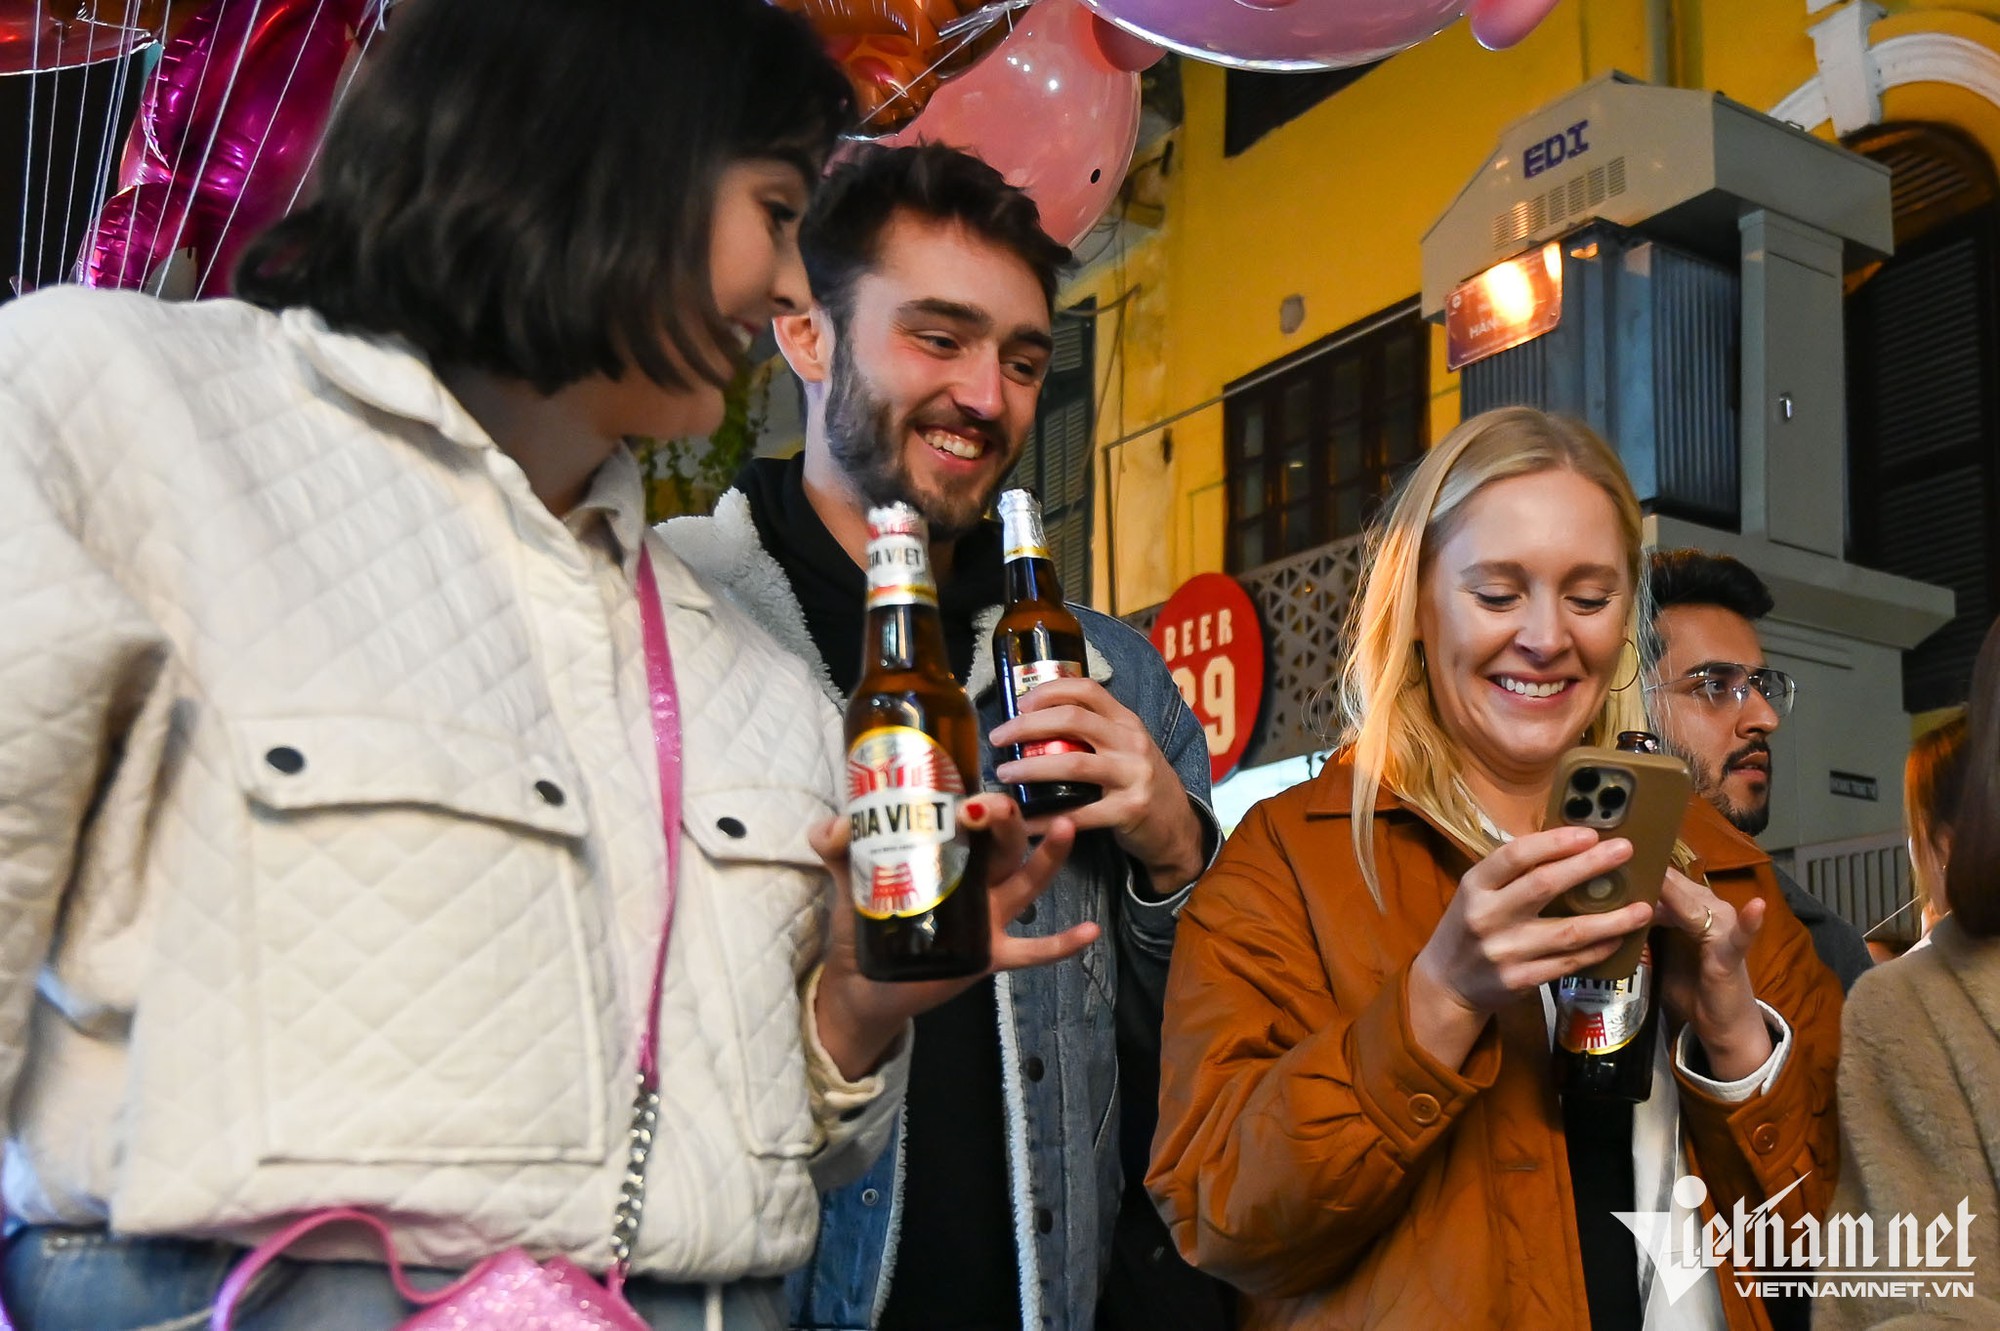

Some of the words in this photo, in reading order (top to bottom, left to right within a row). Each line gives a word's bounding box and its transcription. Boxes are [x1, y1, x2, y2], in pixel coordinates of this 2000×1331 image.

[1523, 119, 1589, 179] EDI
[1164, 608, 1234, 663] BEER
[852, 808, 881, 841] BIA
